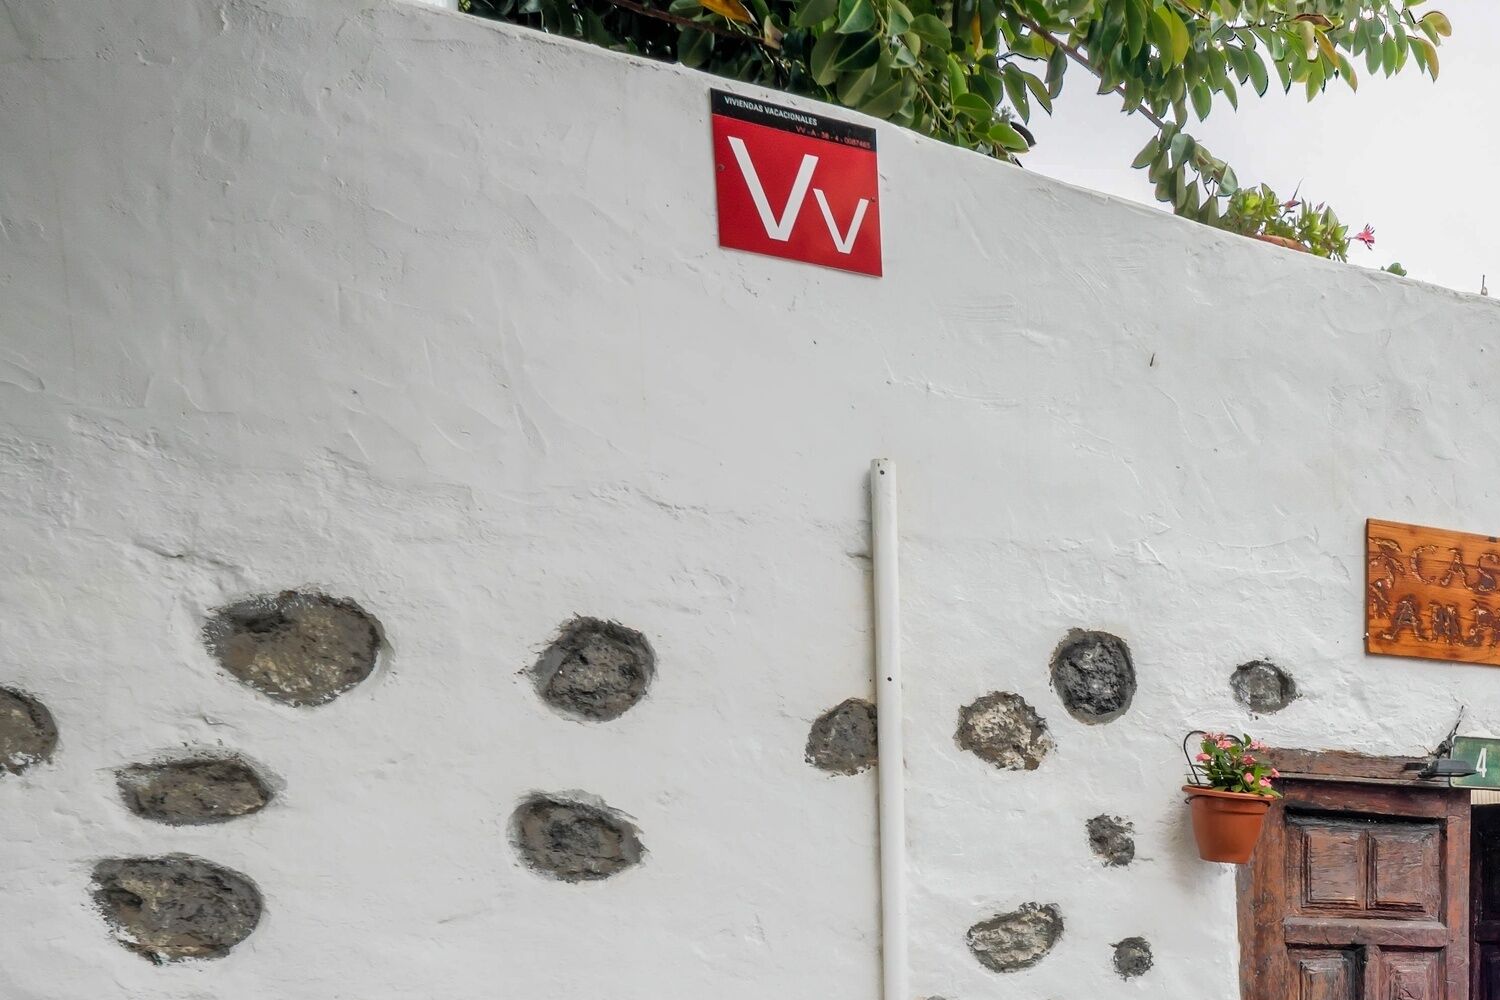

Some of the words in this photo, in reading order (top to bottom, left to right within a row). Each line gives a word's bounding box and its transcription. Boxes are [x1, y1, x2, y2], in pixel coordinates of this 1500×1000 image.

[724, 95, 763, 112] VIVIENDAS
[764, 106, 817, 126] VACACIONALES
[727, 136, 869, 254] Vv
[1475, 747, 1487, 778] 4
